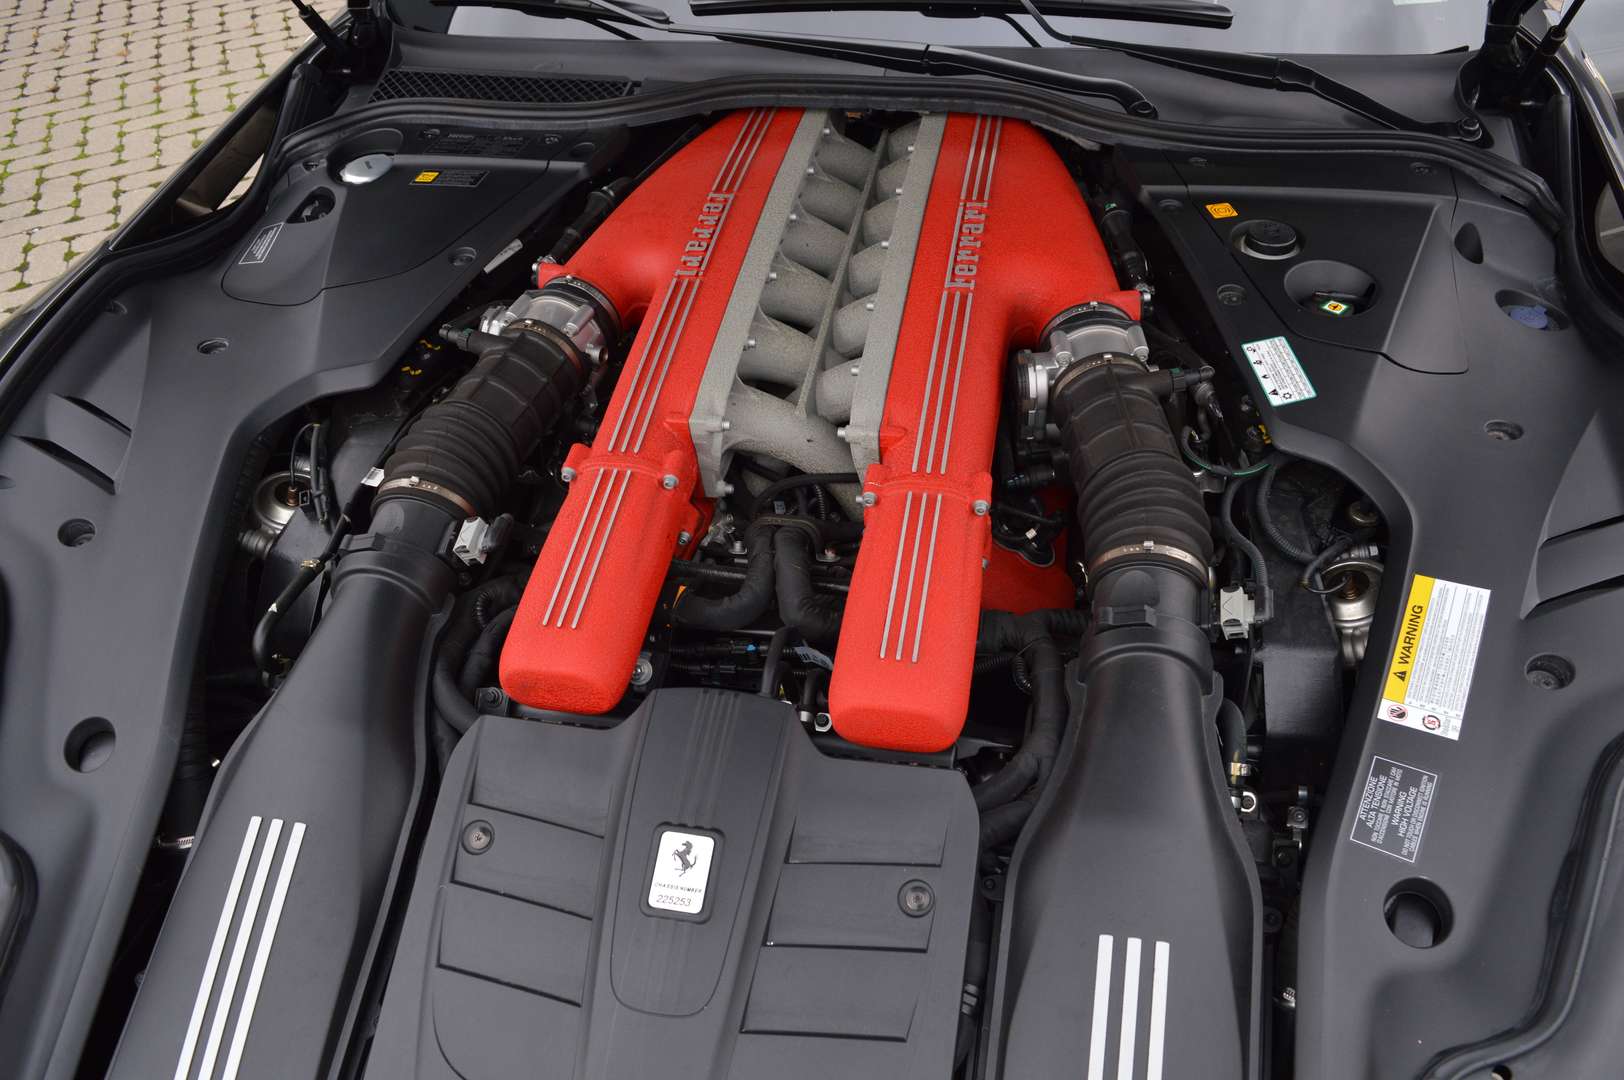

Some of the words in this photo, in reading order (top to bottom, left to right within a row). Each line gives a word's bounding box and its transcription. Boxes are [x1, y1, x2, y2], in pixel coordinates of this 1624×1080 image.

[675, 191, 735, 277] Ferrari
[945, 201, 989, 289] Ferrari
[1398, 604, 1423, 664] WARNING
[1359, 776, 1378, 821] ATTENZIONE
[1370, 774, 1388, 810] TENSIONE
[1391, 791, 1407, 826] WARNING
[1403, 786, 1418, 817] VOLTAGE
[1366, 811, 1377, 828] ALTA
[1398, 818, 1409, 837] HIGH
[656, 894, 692, 906] 225253
